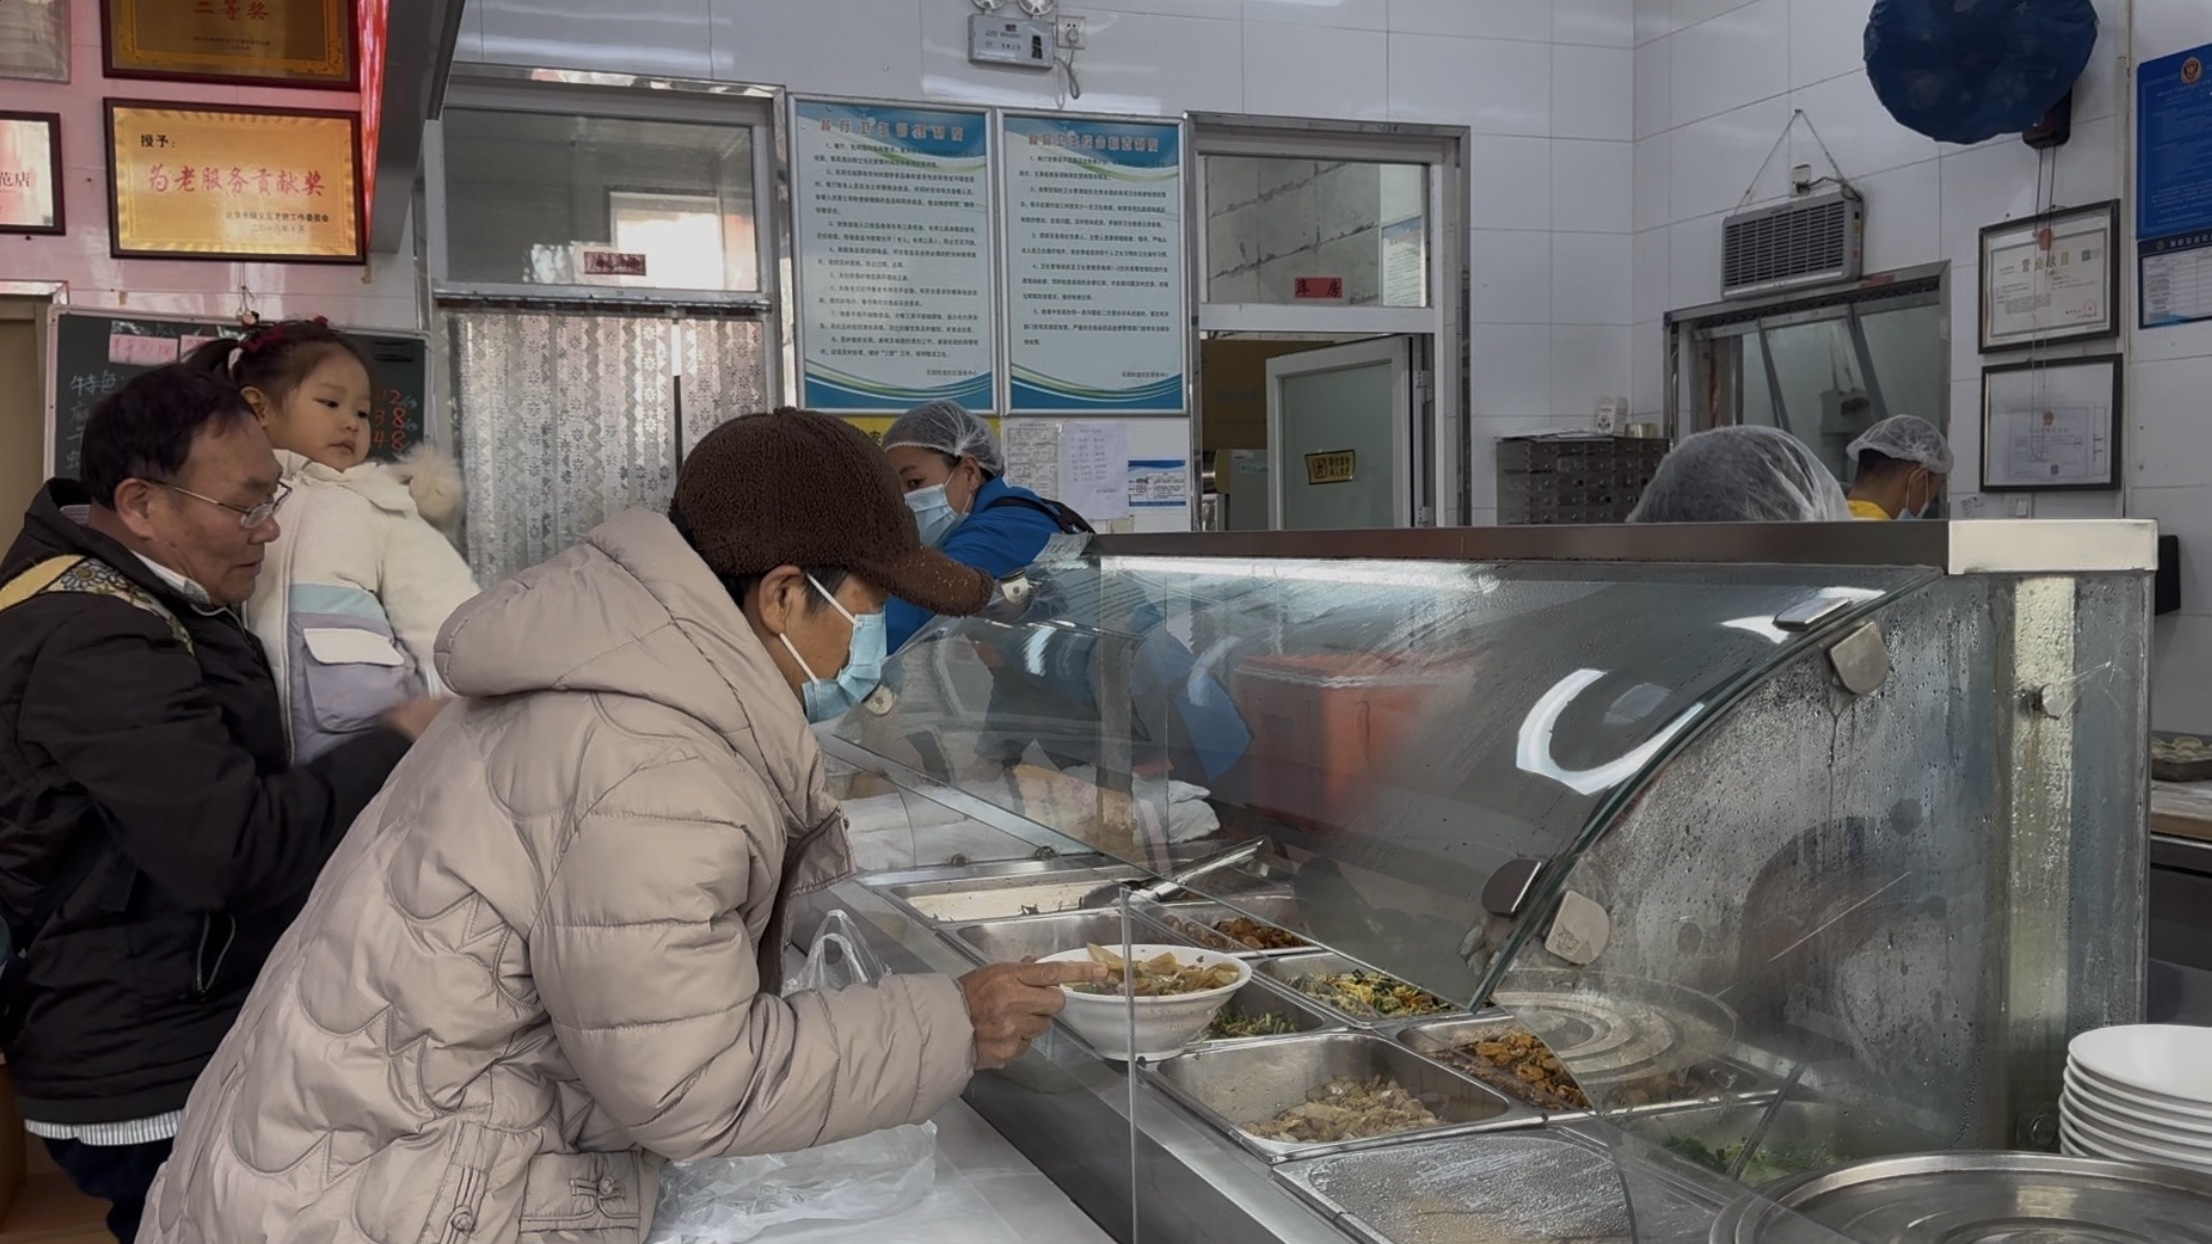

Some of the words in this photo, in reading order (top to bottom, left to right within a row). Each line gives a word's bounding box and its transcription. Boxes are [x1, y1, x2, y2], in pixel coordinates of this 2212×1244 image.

[148, 164, 325, 197] 为老服务贡献奖
